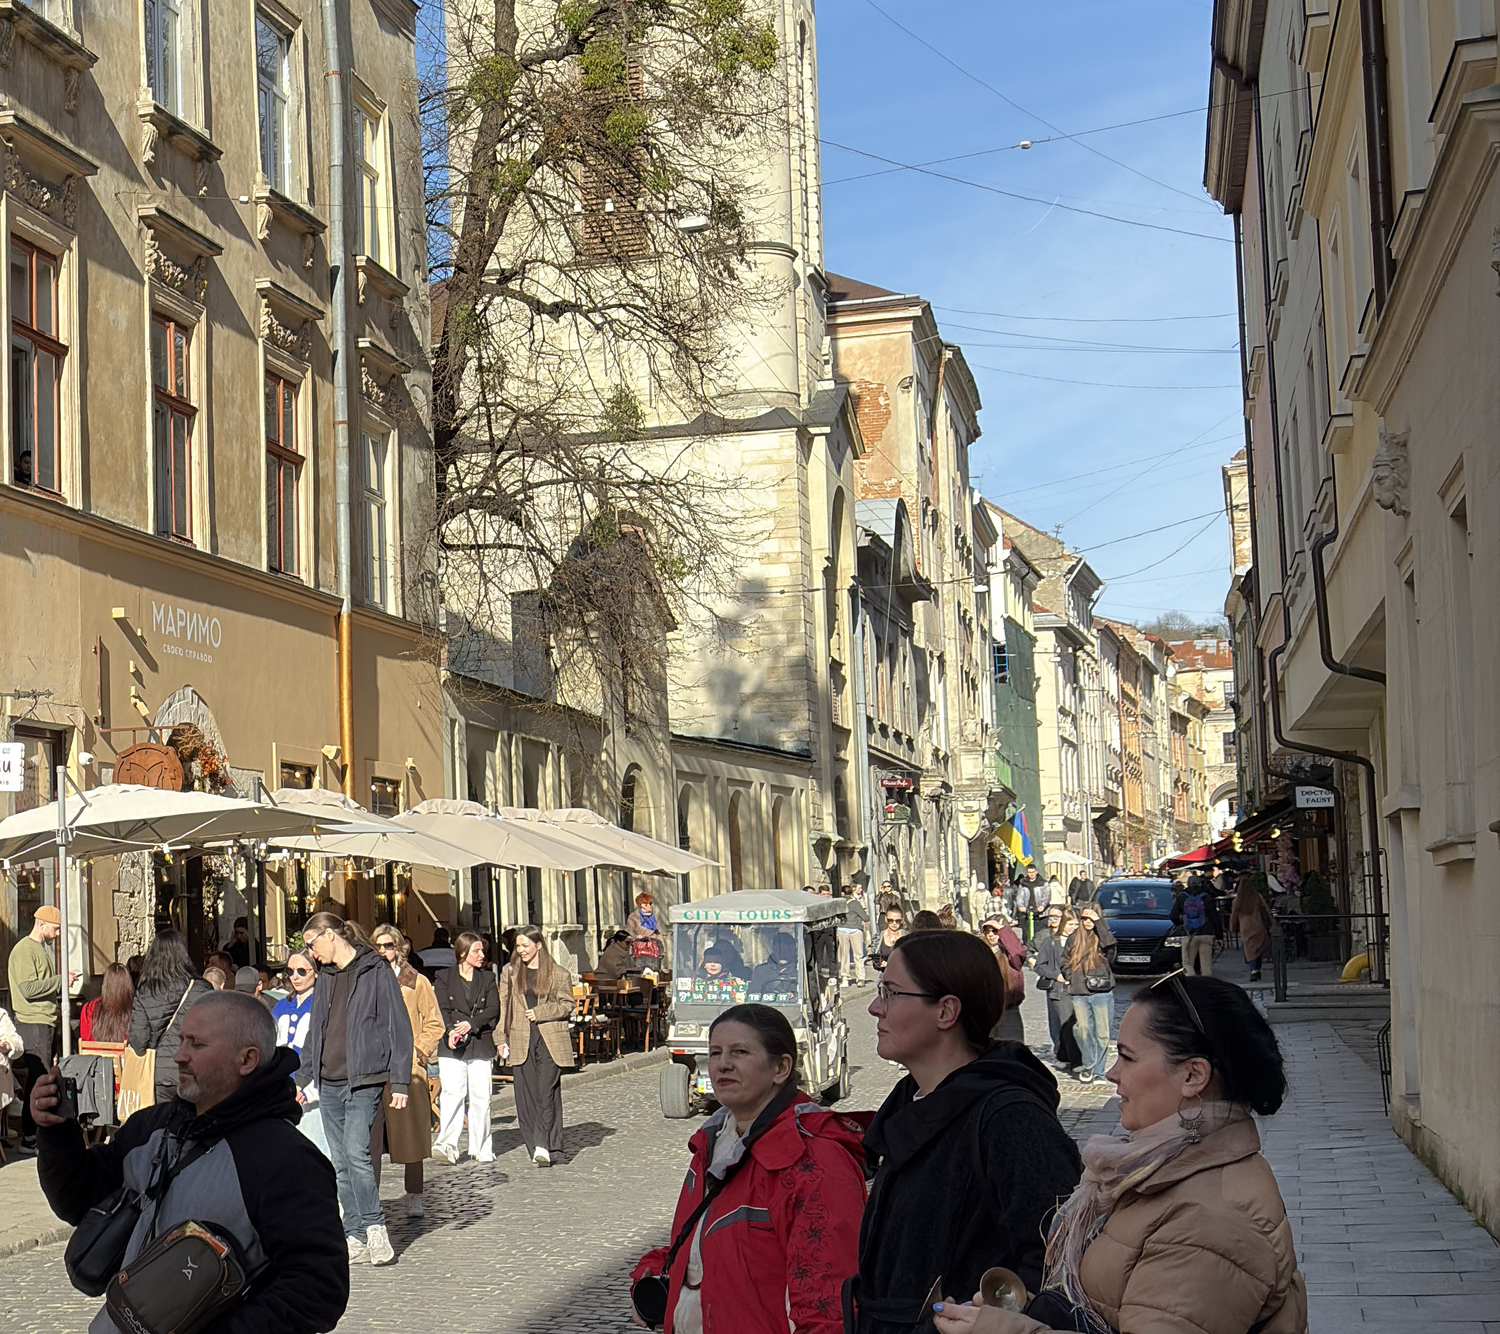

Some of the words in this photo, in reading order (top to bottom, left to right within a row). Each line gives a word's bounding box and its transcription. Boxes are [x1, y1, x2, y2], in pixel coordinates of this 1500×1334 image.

[151, 600, 222, 648] МАРИМО
[162, 643, 184, 657] СВОЄЮ
[185, 649, 213, 663] СПРАВОЮ
[683, 909, 721, 920] CITY
[738, 909, 792, 920] TOURS
